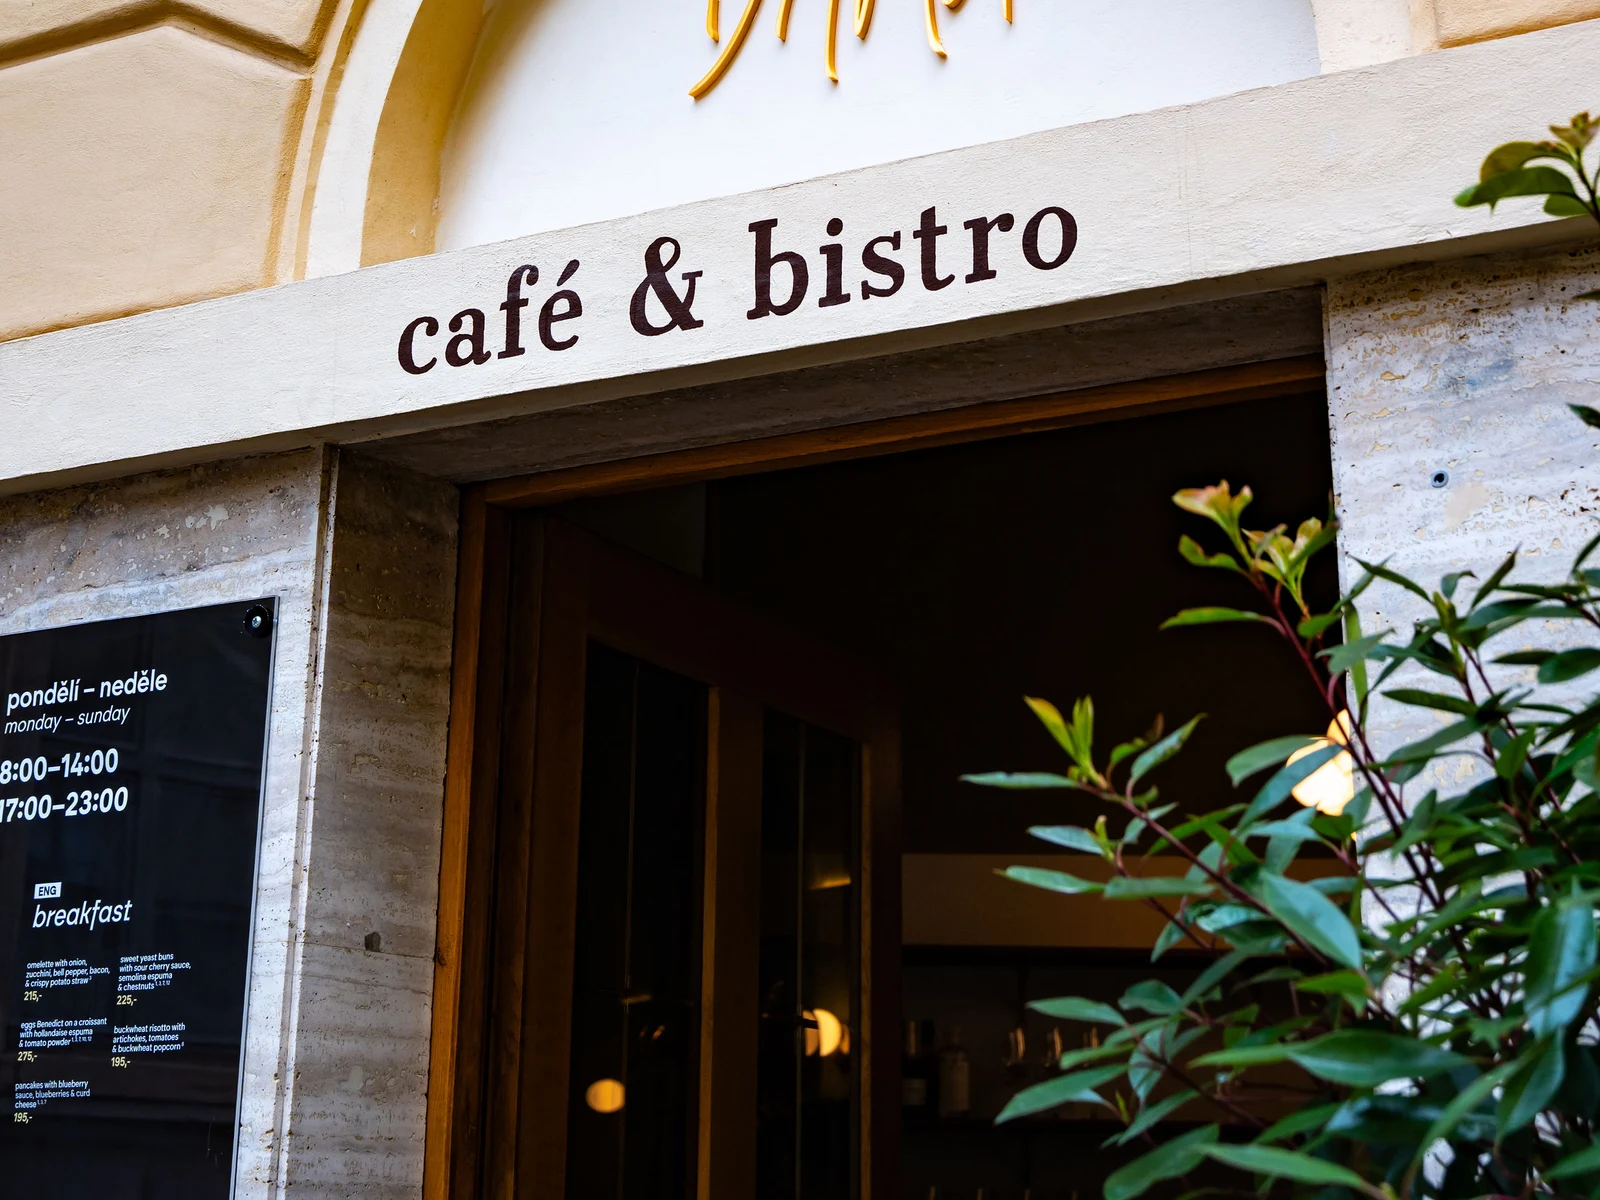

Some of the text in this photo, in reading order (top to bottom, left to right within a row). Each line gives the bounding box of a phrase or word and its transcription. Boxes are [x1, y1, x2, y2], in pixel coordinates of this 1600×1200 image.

[397, 205, 1079, 375] café & bistro
[6, 678, 81, 716] pondělí
[99, 669, 168, 698] neděle
[4, 713, 62, 734] monday
[77, 705, 131, 725] sunday
[38, 885, 57, 896] ENG
[32, 900, 133, 931] breakfast
[26, 958, 87, 969] omelette with onion,
[120, 952, 174, 964] sweet yeast buns
[25, 966, 111, 978] zucchini, bell pepper, bacon,
[119, 964, 133, 972] with
[149, 962, 170, 972] cherry
[170, 962, 191, 970] sauce,
[118, 972, 173, 982] semolina espuma
[30, 979, 50, 988] crispy
[50, 978, 71, 988] potato
[117, 983, 122, 992] &
[23, 990, 42, 1002] 215,-
[116, 994, 137, 1006] 225,-
[20, 1022, 36, 1031] eggs
[36, 1019, 64, 1028] Benedict
[78, 1017, 107, 1026] croissant
[113, 1022, 186, 1034] buckwheat risotto with
[19, 1028, 93, 1038] with hollandaise espuma
[112, 1034, 179, 1043] artichokes, tomatoes
[18, 1040, 24, 1048] &
[24, 1040, 46, 1048] tomato
[111, 1045, 117, 1053] &
[118, 1044, 152, 1053] buckwheat
[17, 1051, 38, 1062] 275,-
[111, 1056, 131, 1069] 195,-
[14, 1080, 89, 1091] pancakes with blueberry
[35, 1090, 70, 1099] blueberries
[76, 1088, 91, 1097] curd
[14, 1100, 37, 1109] cheese
[13, 1112, 33, 1124] 195,-
